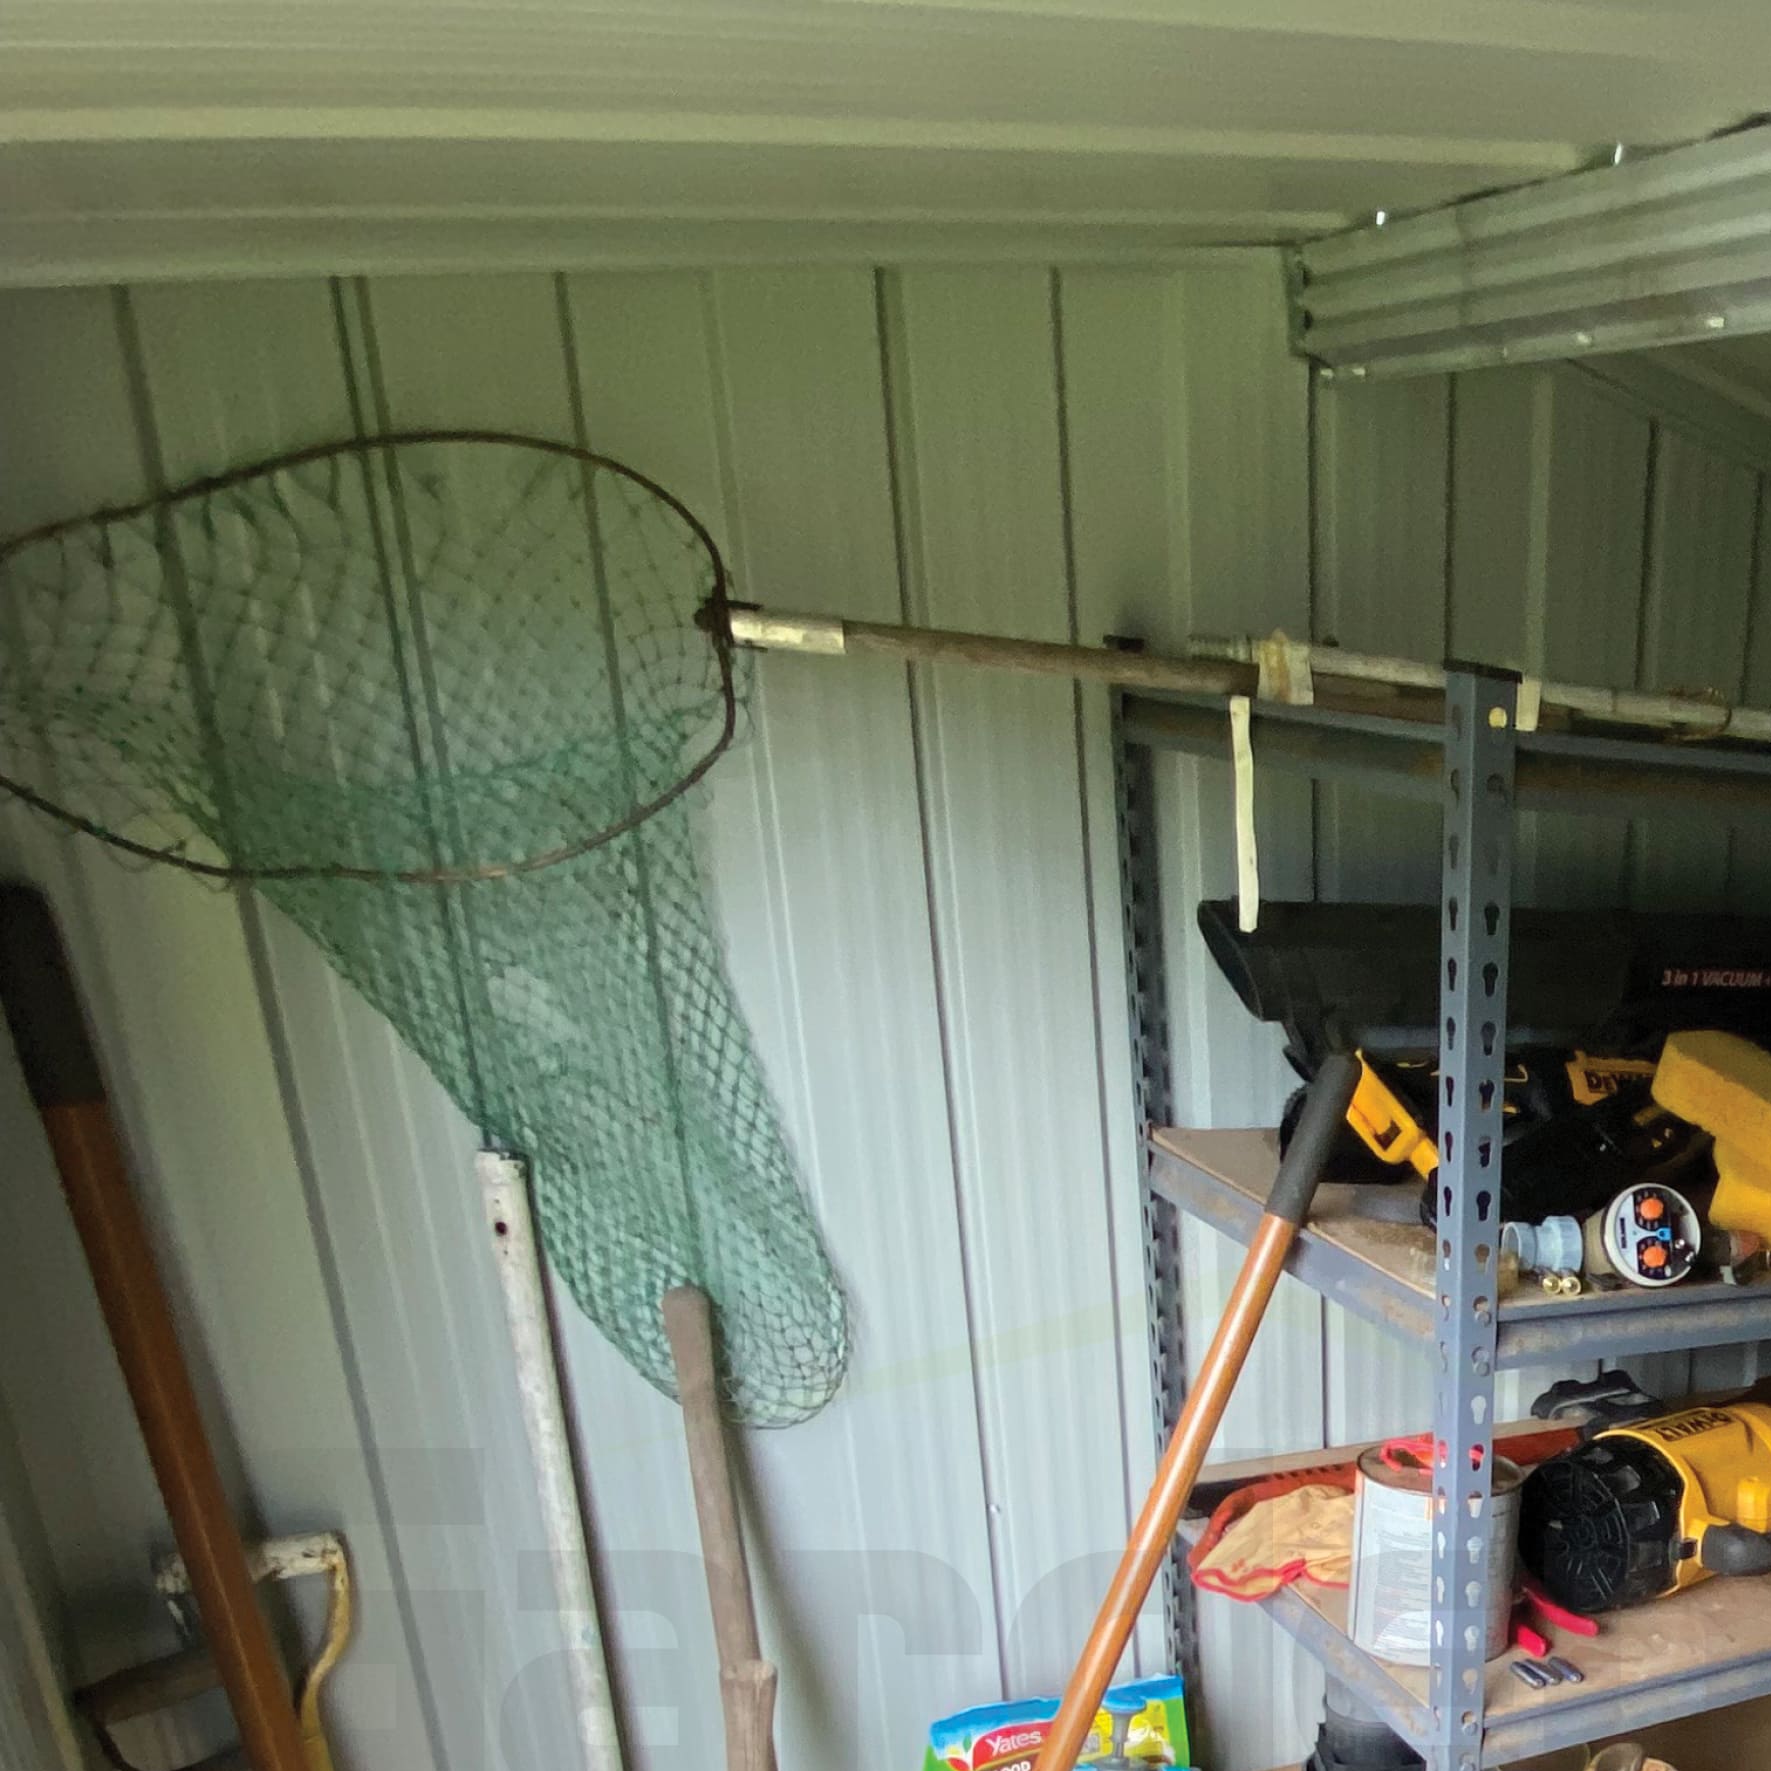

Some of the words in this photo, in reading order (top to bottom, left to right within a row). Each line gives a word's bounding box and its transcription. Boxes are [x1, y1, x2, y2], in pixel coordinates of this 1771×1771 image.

[1662, 969, 1672, 987] 3
[1702, 970, 1763, 987] VACUUM
[985, 1730, 1042, 1756] Yates
